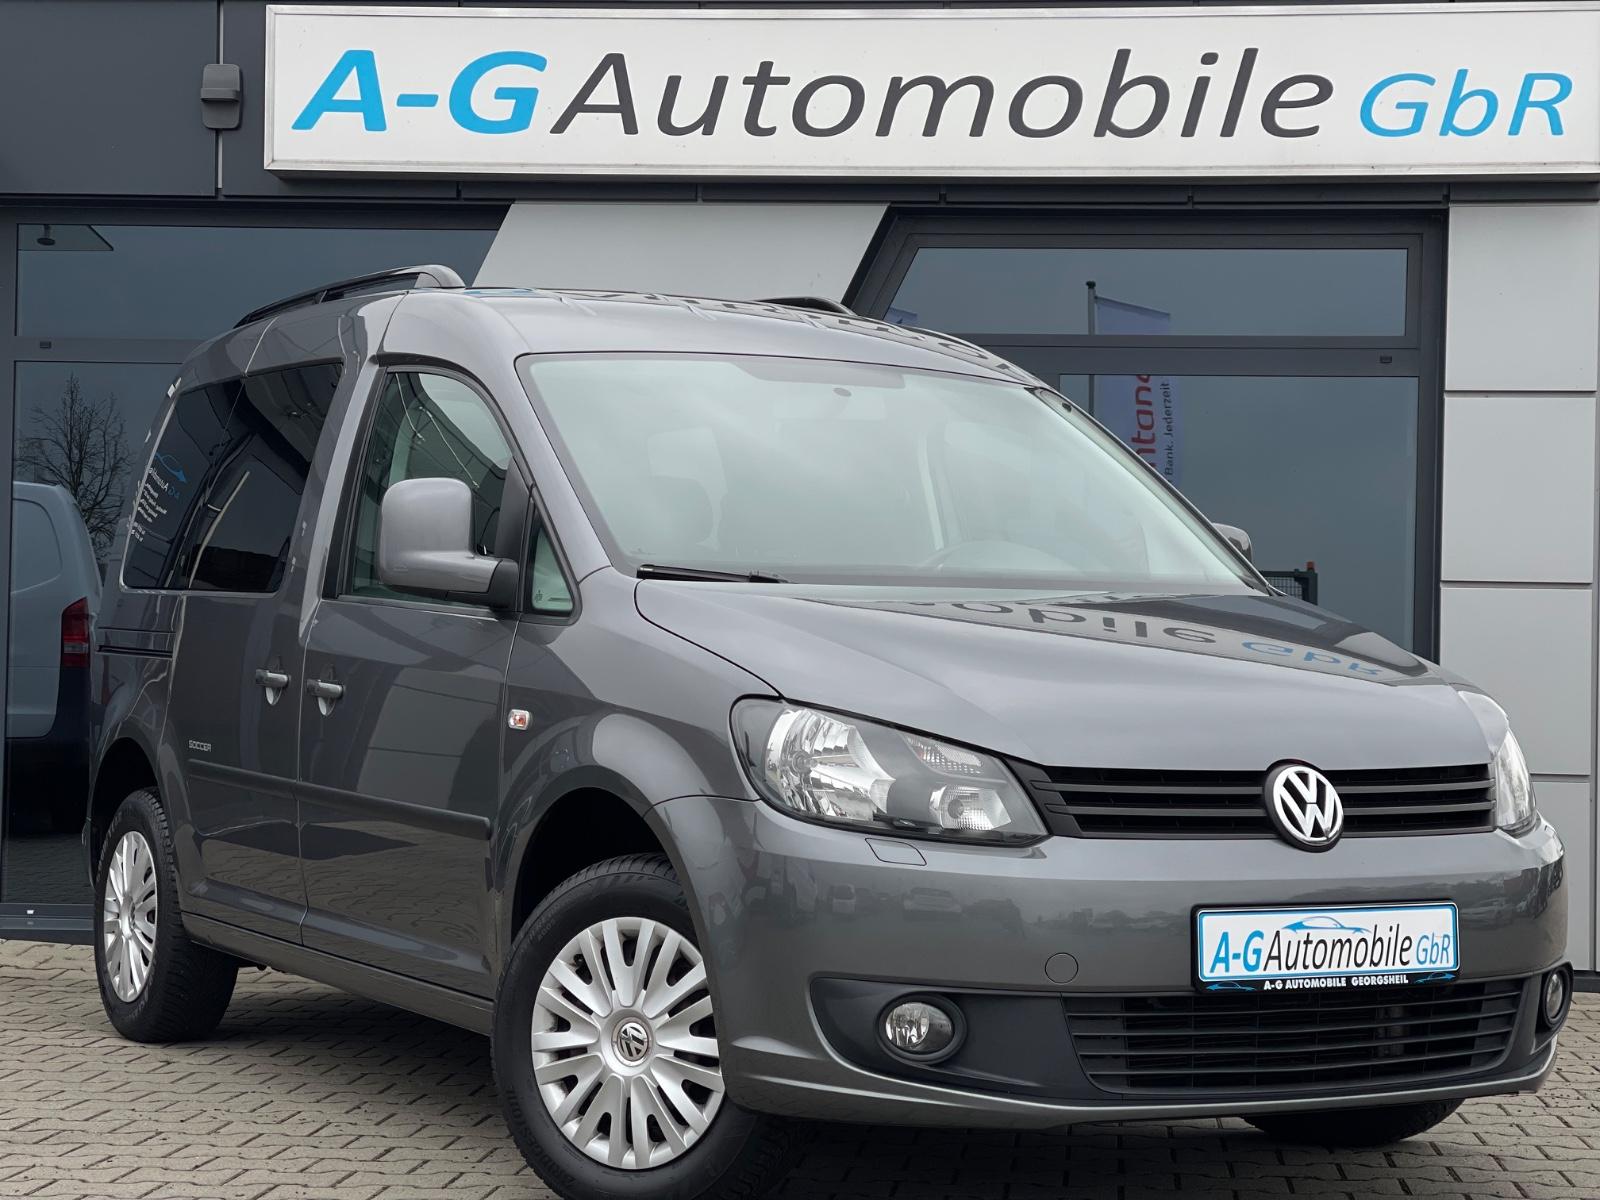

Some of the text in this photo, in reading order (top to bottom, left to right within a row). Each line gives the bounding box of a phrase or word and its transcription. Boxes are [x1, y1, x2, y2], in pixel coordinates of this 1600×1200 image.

[549, 47, 1334, 138] Automobile
[1359, 68, 1573, 138] GbR
[1159, 382, 1175, 438] Jederzeit
[188, 739, 212, 753] SOCCER
[1263, 923, 1413, 972] Automobile
[1416, 933, 1451, 966] GbR
[1263, 974, 1409, 991] A-G AUTOMOBILE GEORGSHEIL
